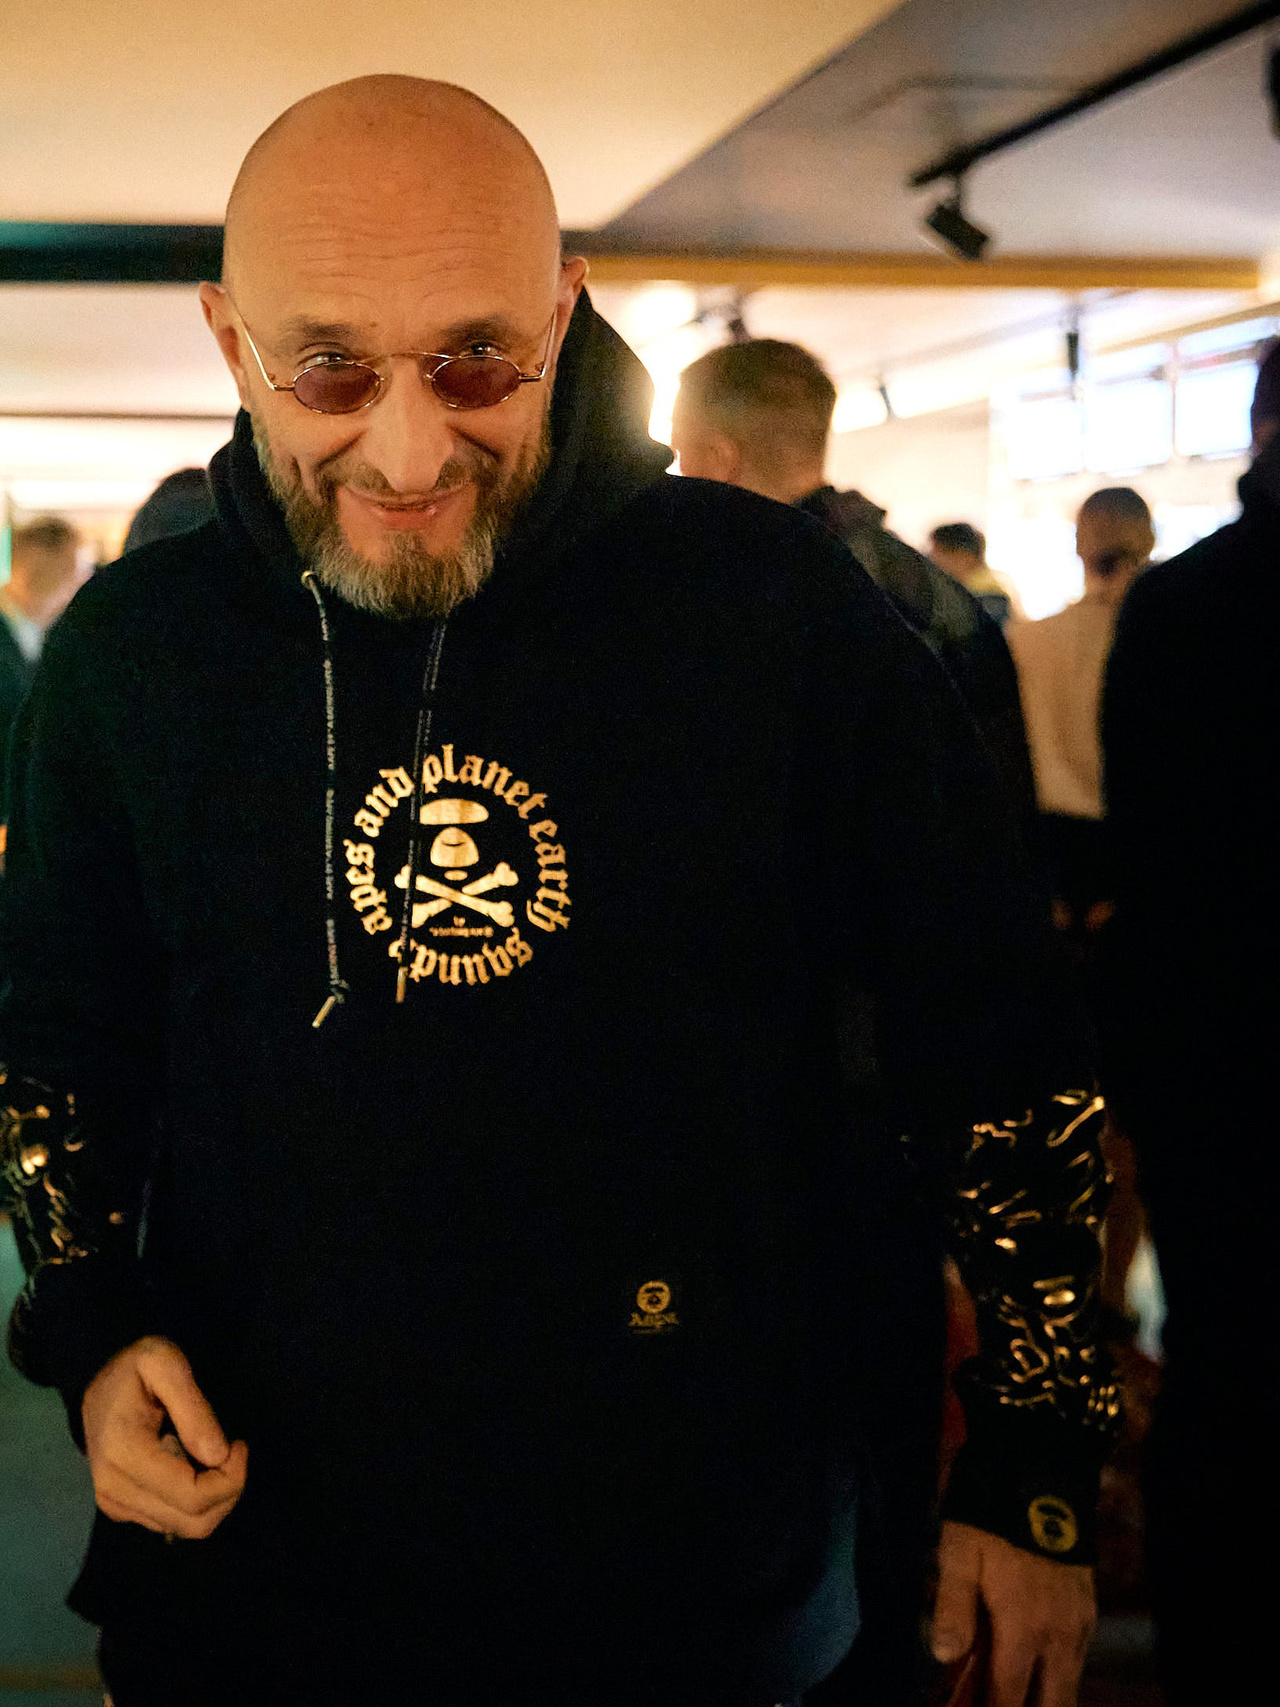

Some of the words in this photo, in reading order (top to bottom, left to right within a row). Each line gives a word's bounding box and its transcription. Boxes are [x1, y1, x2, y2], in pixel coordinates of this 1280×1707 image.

[353, 765, 416, 838] and
[422, 743, 548, 820] planet
[343, 838, 393, 936] apes
[527, 819, 572, 933] earth
